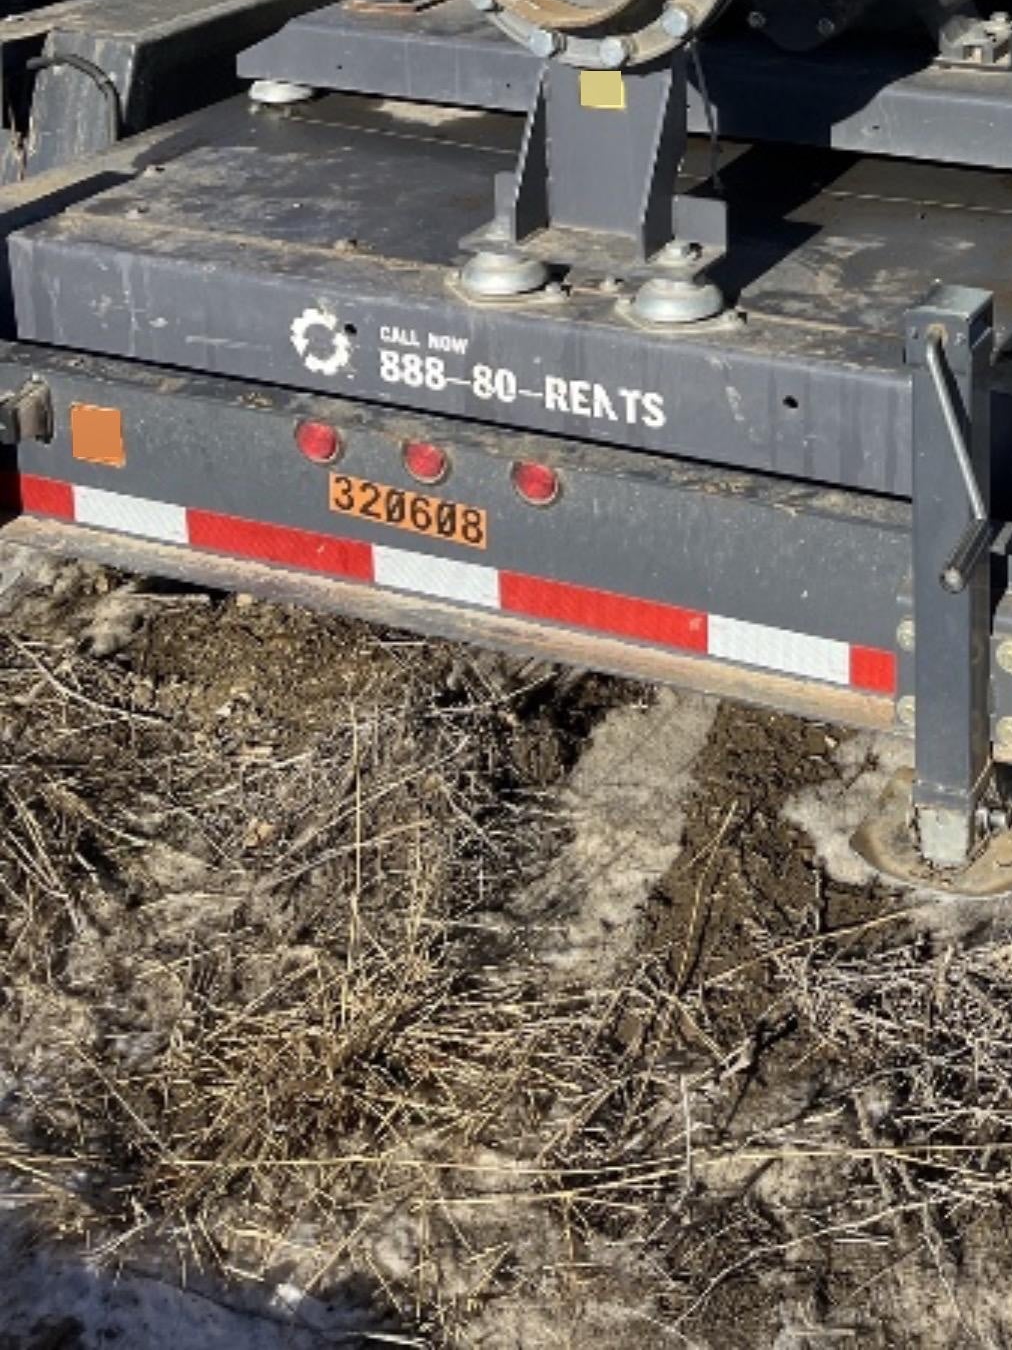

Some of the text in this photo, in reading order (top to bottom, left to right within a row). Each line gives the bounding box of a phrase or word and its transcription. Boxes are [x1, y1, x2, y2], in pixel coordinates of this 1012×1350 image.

[379, 325, 468, 355] CALL NOW
[334, 476, 483, 543] 320608
